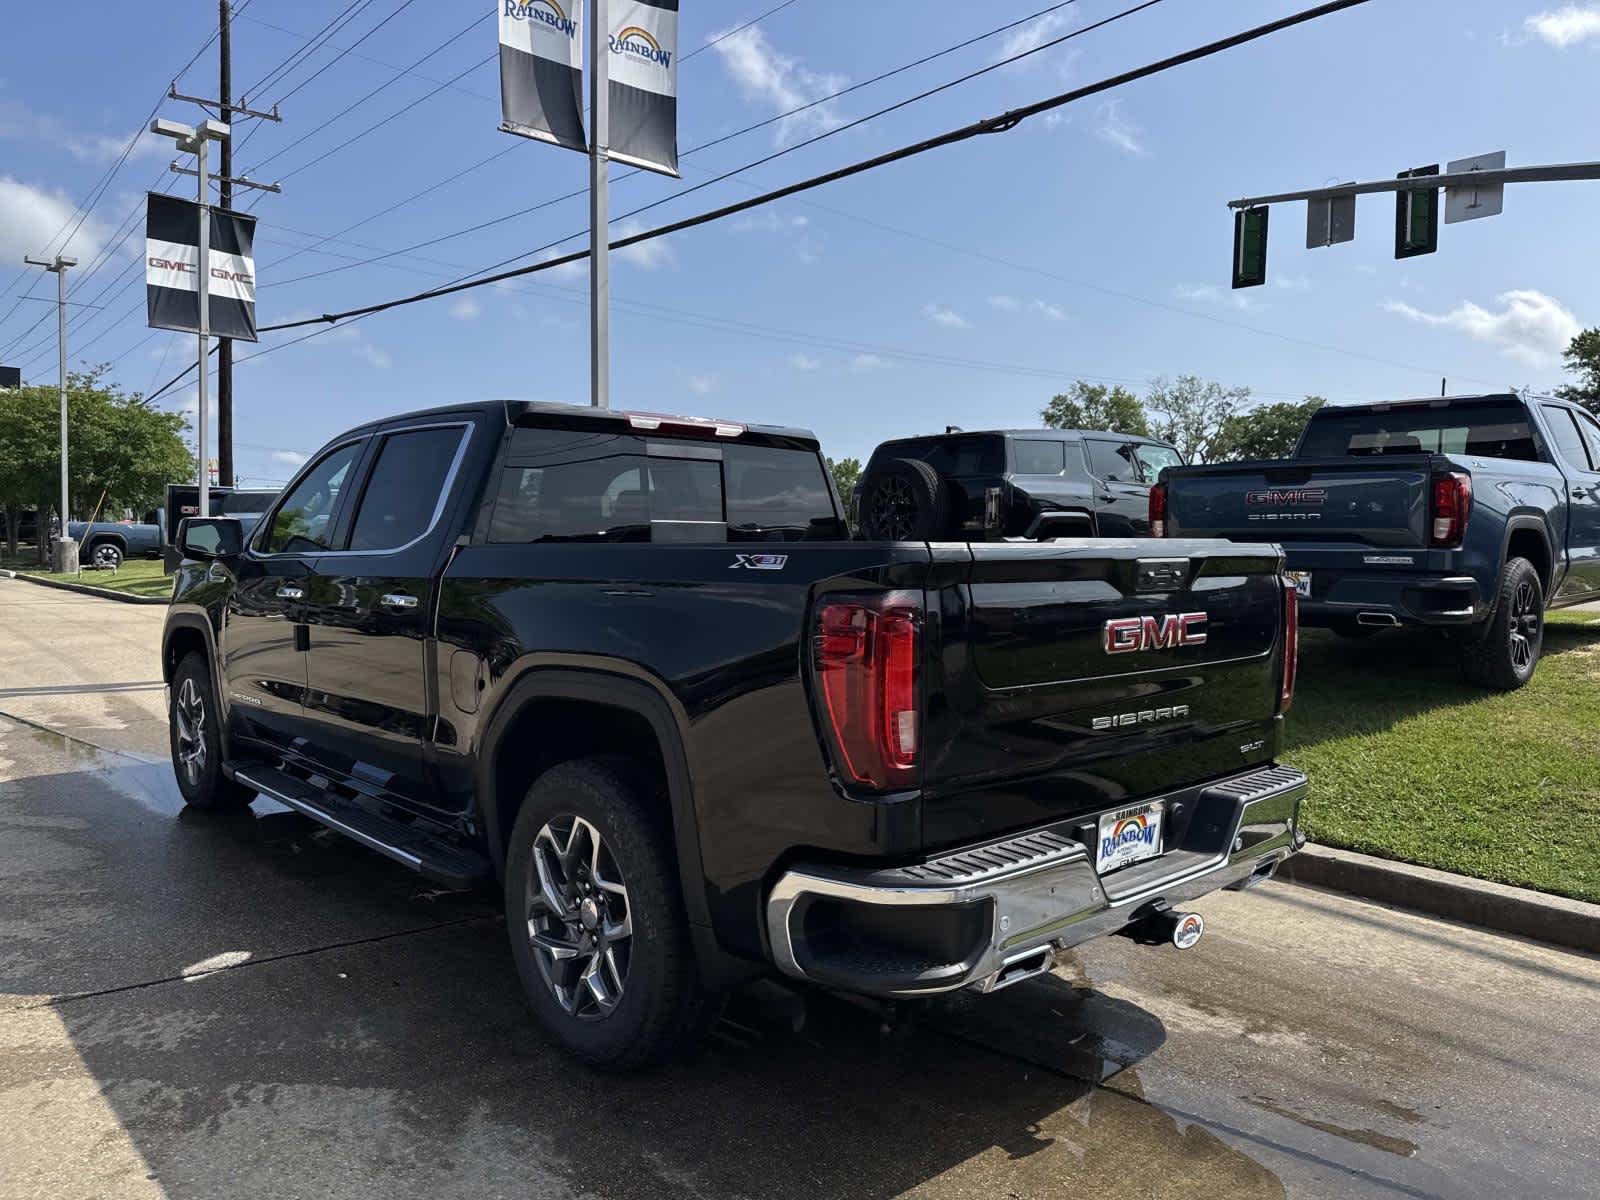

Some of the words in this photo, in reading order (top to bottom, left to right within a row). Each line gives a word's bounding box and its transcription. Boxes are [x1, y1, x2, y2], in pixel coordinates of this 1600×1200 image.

[504, 0, 577, 40] RAINBOW
[608, 34, 672, 69] RAINBOW
[148, 257, 197, 275] GMC
[210, 267, 254, 285] GMC
[1245, 489, 1326, 505] GMC
[1104, 611, 1208, 655] GMC
[1092, 705, 1190, 731] SIERRA
[1240, 740, 1265, 753] SLT
[1100, 823, 1157, 860] RAINBOW
